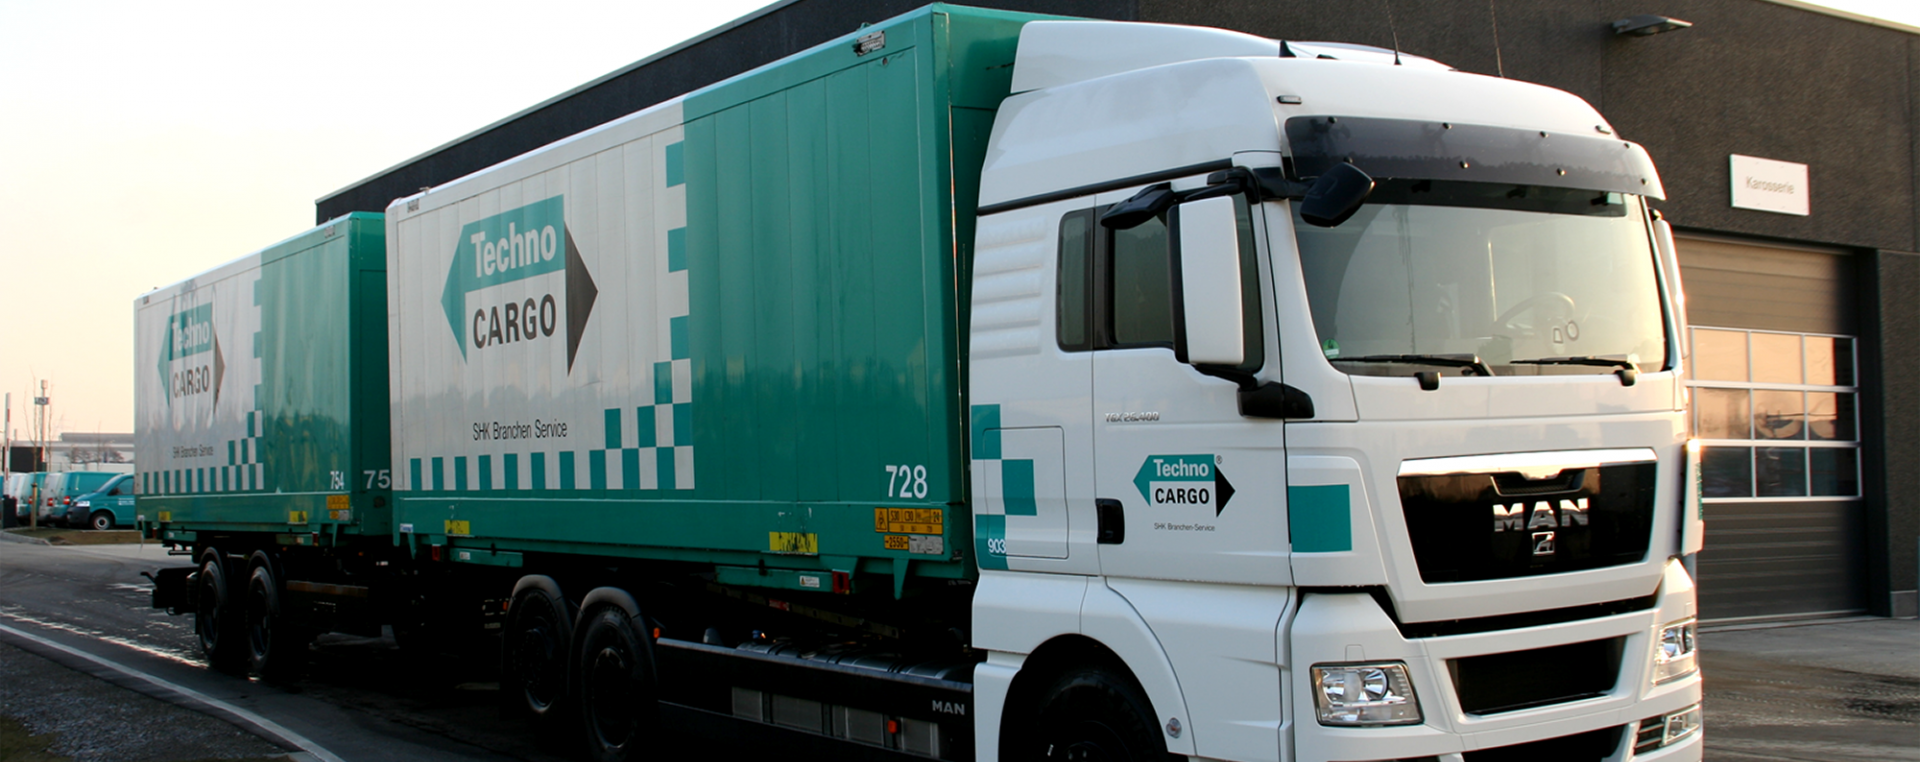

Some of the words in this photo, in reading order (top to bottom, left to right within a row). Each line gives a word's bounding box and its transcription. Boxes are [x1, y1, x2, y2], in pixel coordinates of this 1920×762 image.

[1746, 176, 1794, 194] Karosserie
[470, 220, 557, 279] Techno
[472, 293, 557, 350] CARGO
[172, 316, 211, 353] Techno
[173, 364, 211, 399] CARGO
[472, 422, 491, 442] SHK
[493, 420, 533, 441] Branchen
[534, 418, 568, 440] Service
[1153, 458, 1210, 478] Techno
[329, 470, 344, 490] 754
[885, 464, 928, 499] 728
[1155, 488, 1210, 505] CARGO
[1493, 498, 1589, 531] MAN
[1154, 522, 1167, 531] SHK
[1168, 522, 1215, 532] Branchen-Service
[988, 538, 1006, 554] 903
[932, 700, 965, 715] MAN
